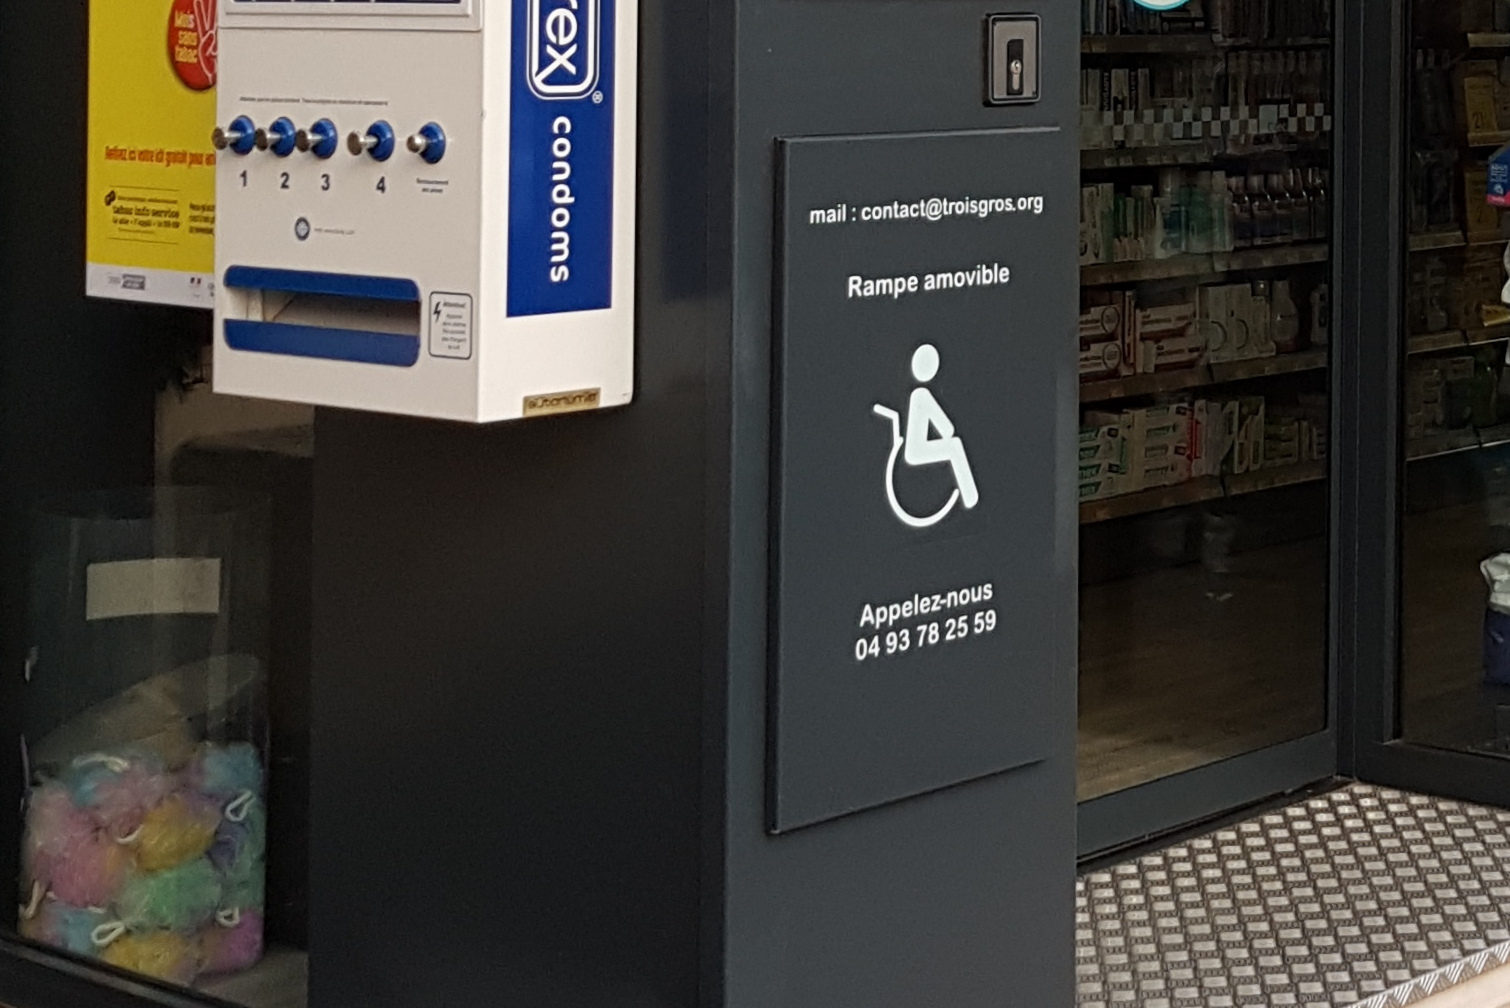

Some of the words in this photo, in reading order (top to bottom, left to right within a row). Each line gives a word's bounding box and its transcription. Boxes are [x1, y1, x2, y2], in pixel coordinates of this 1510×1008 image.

[239, 170, 247, 187] 1
[280, 172, 290, 189] 2
[321, 173, 330, 191] 3
[376, 176, 386, 193] 4
[550, 116, 575, 282] condoms
[810, 203, 847, 224] mail
[861, 196, 1043, 221] contact@troisgros.org
[848, 275, 918, 299] Rampe
[923, 262, 1010, 290] amovible
[859, 582, 993, 629] Appelez-nous
[855, 635, 880, 660] 04
[886, 628, 910, 654] 93
[916, 622, 939, 647] 78
[945, 615, 968, 641] 25
[973, 609, 997, 634] 59
